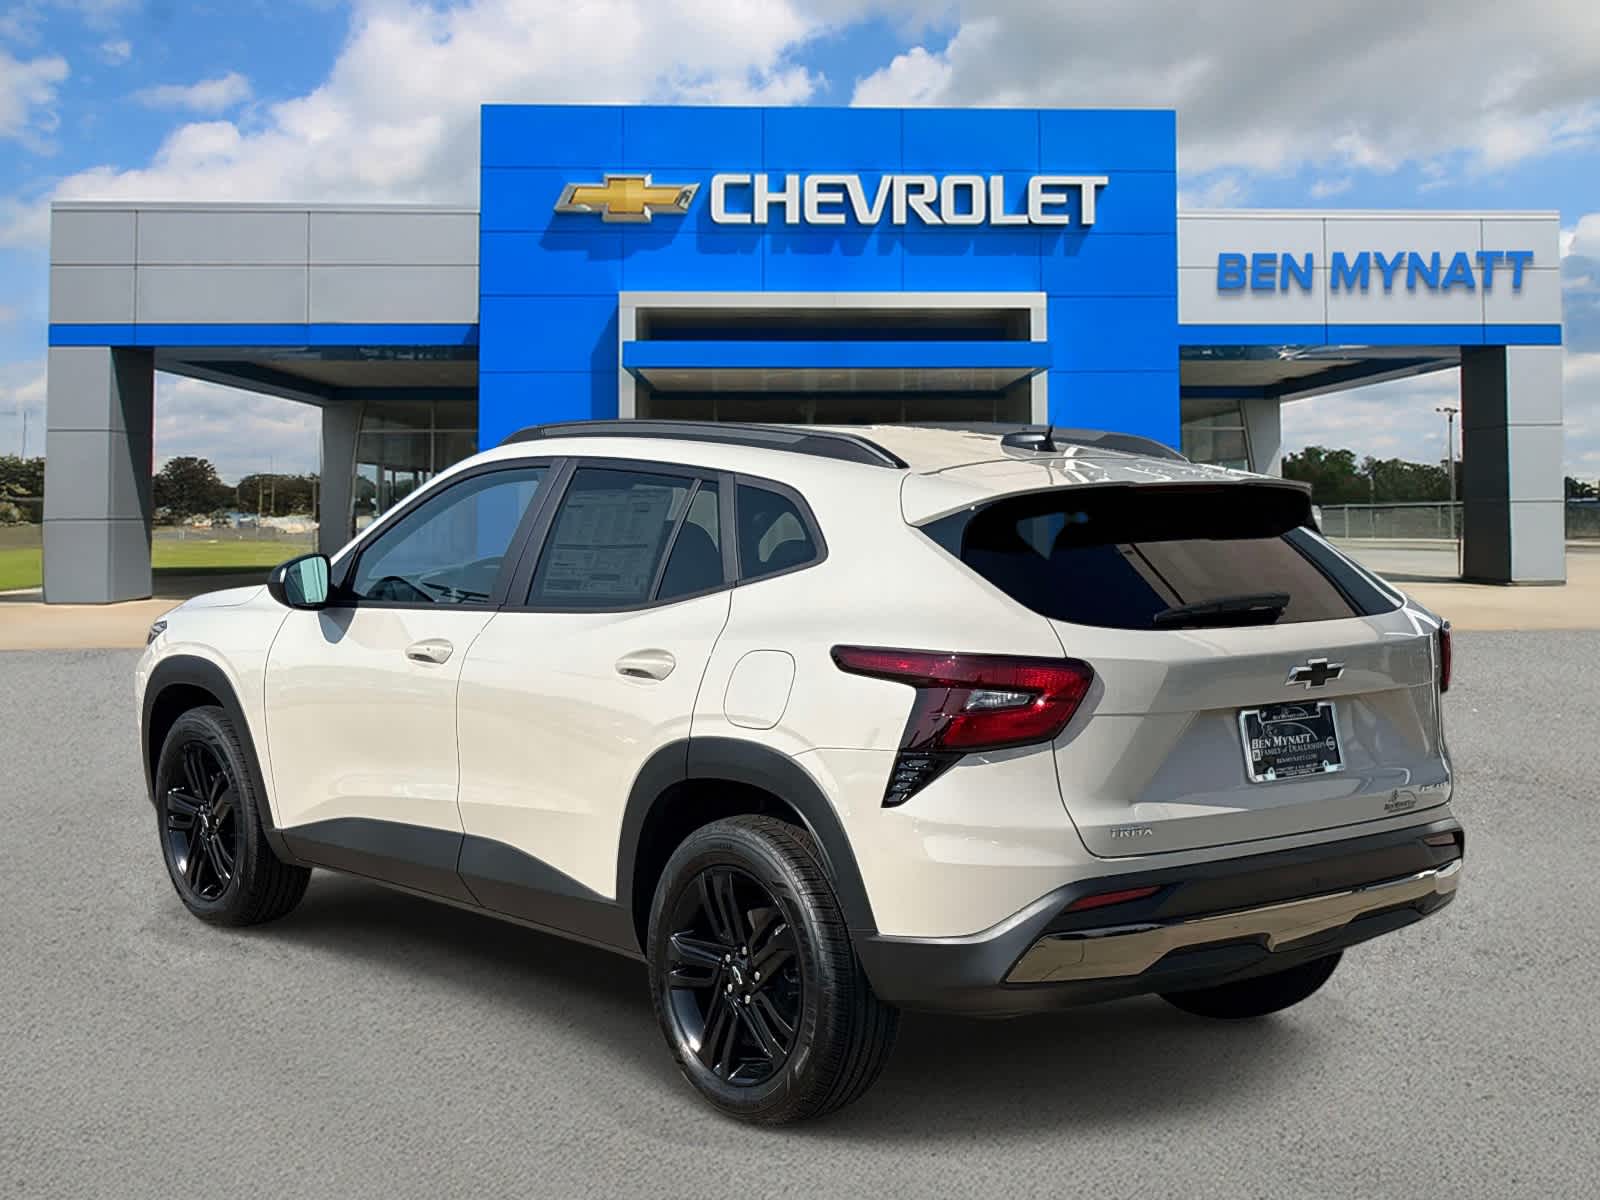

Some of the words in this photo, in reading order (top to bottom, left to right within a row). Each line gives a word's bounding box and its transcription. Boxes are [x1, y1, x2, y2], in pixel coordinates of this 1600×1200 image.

[710, 173, 1110, 226] CHEVROLET
[1216, 252, 1314, 290] BEN
[1329, 250, 1534, 290] MYNATT
[1251, 738, 1272, 749] BEN
[1273, 733, 1312, 747] MYNATT
